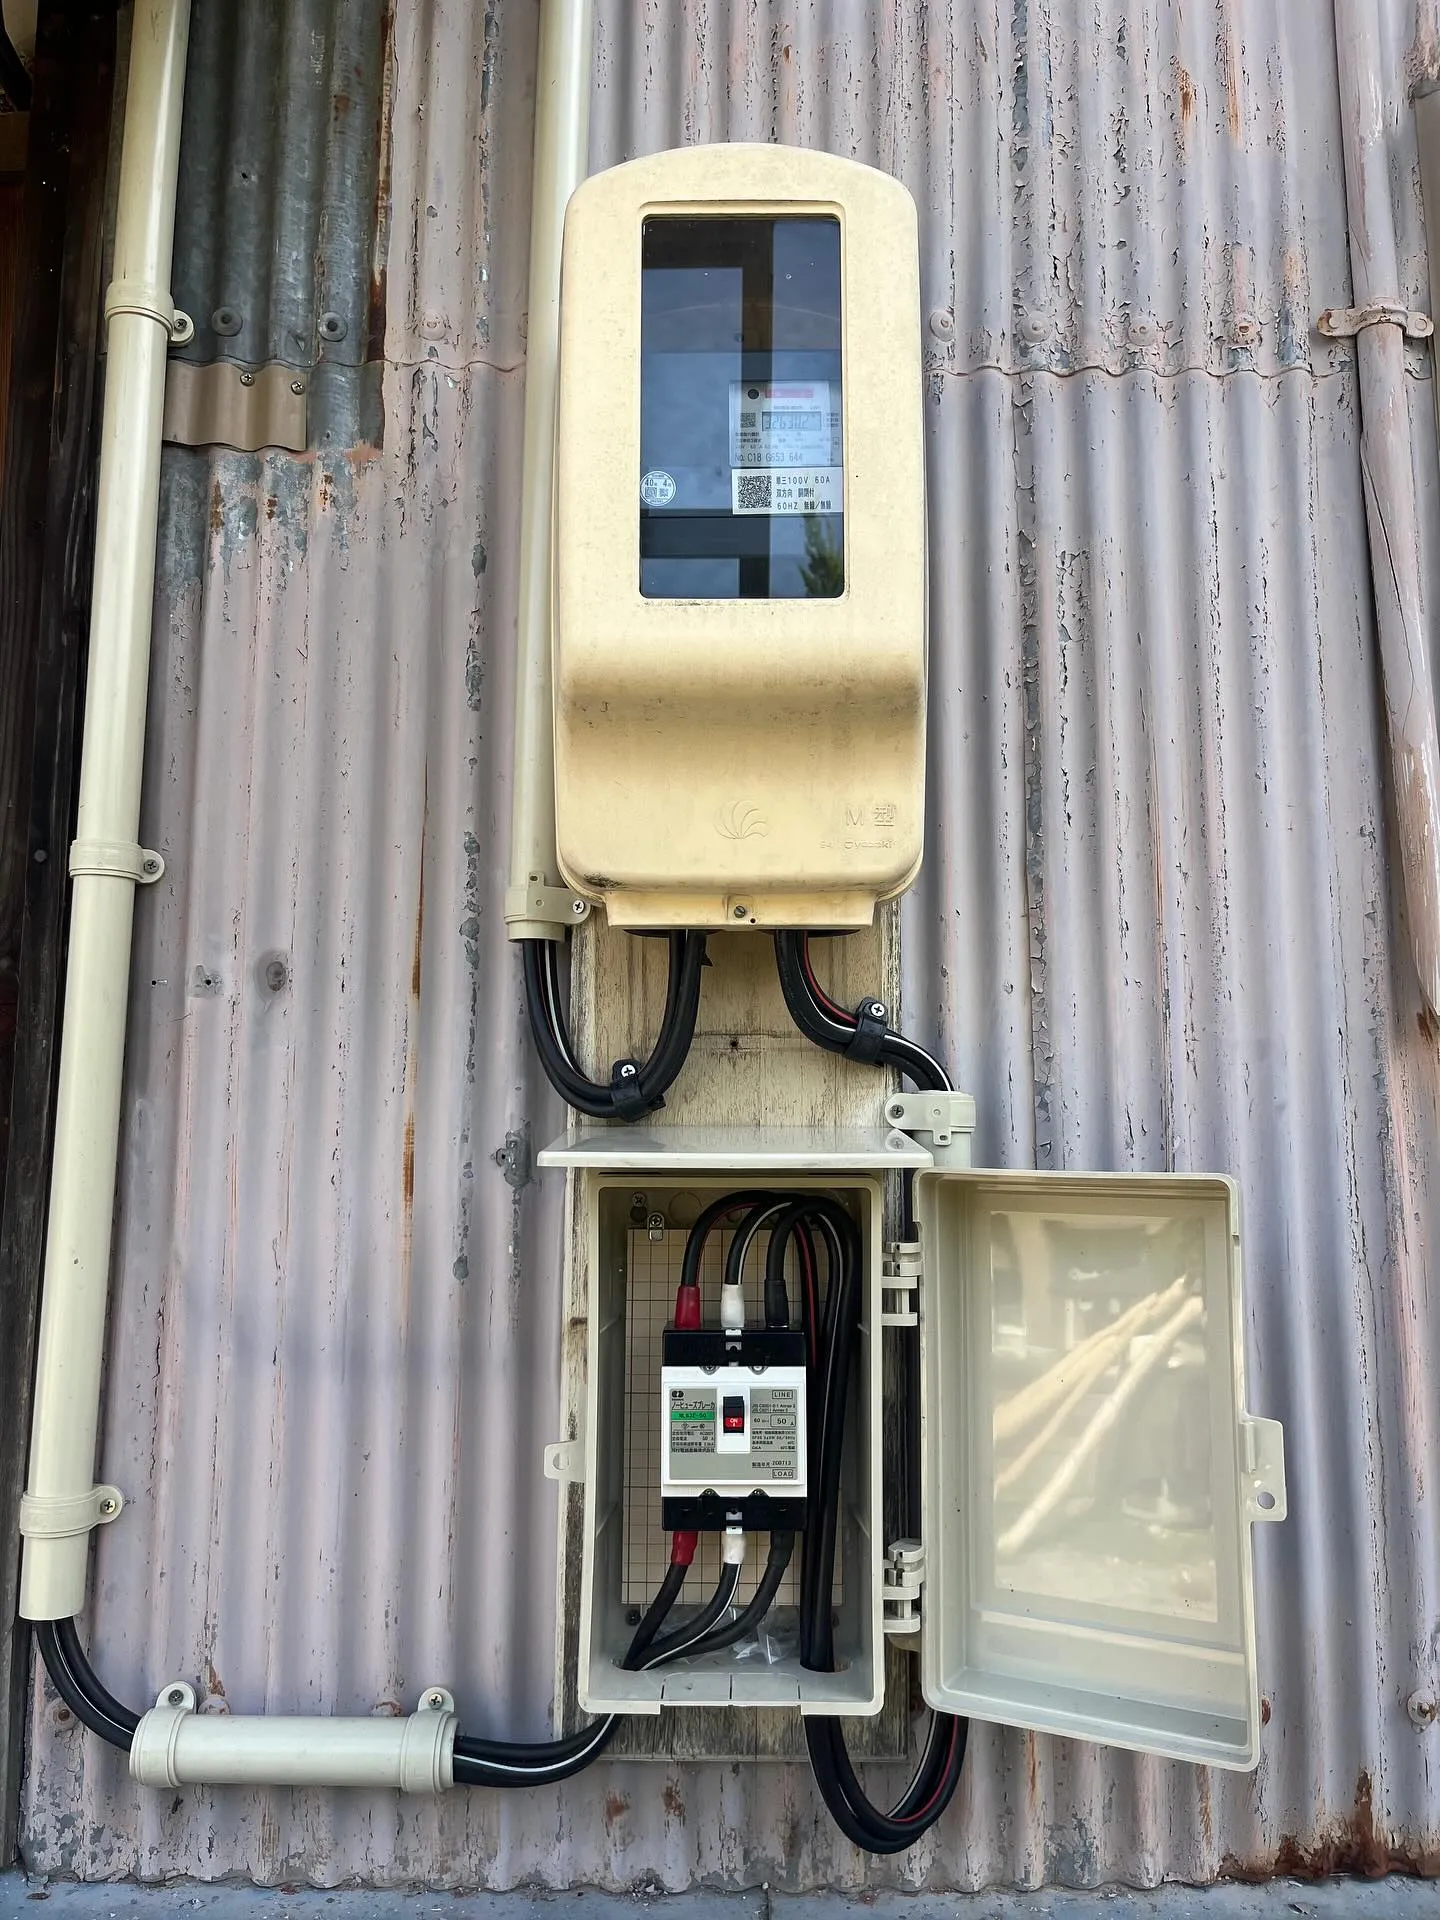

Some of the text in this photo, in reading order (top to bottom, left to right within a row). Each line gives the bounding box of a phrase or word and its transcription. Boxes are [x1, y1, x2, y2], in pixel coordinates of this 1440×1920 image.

[747, 452, 762, 462] C18
[815, 475, 831, 484] 60A
[777, 501, 799, 511] 60HZ
[776, 1417, 787, 1425] 50
